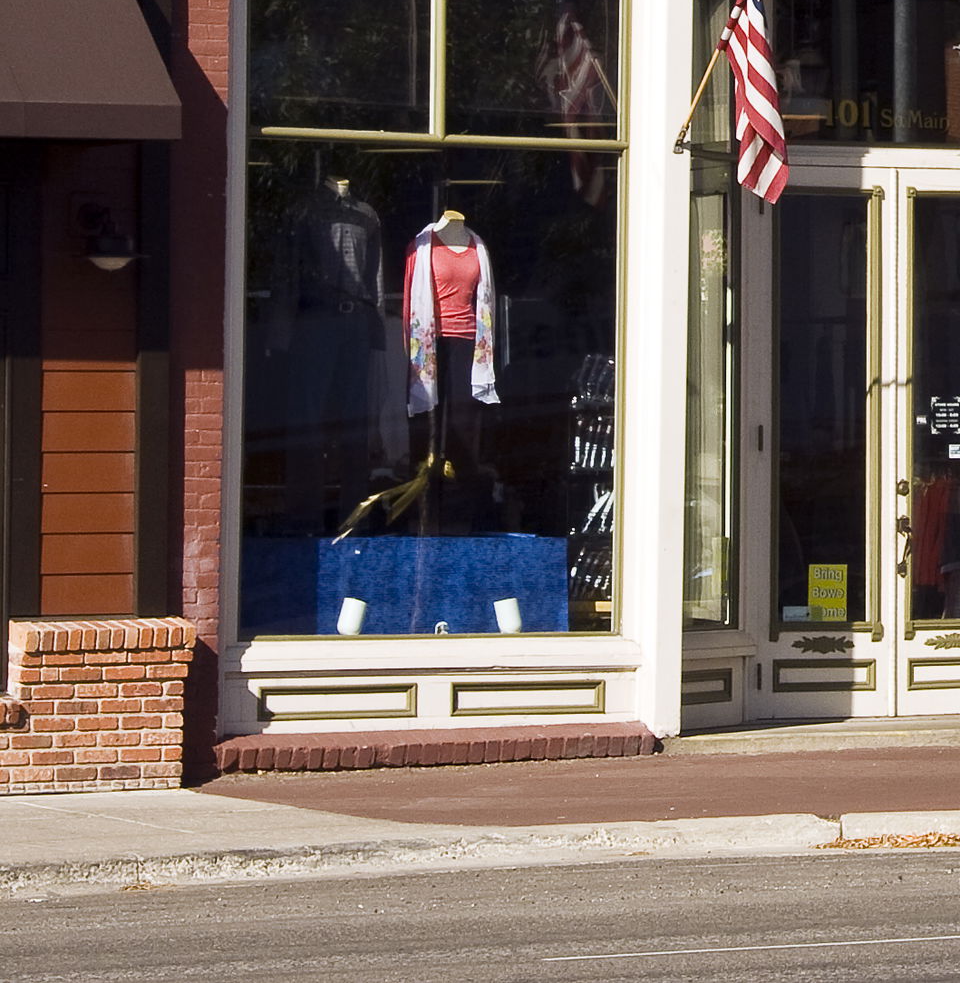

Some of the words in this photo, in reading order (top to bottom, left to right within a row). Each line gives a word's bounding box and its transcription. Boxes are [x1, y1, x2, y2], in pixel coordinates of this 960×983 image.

[824, 98, 869, 128] 101
[907, 109, 949, 130] Main
[813, 568, 843, 582] Bring
